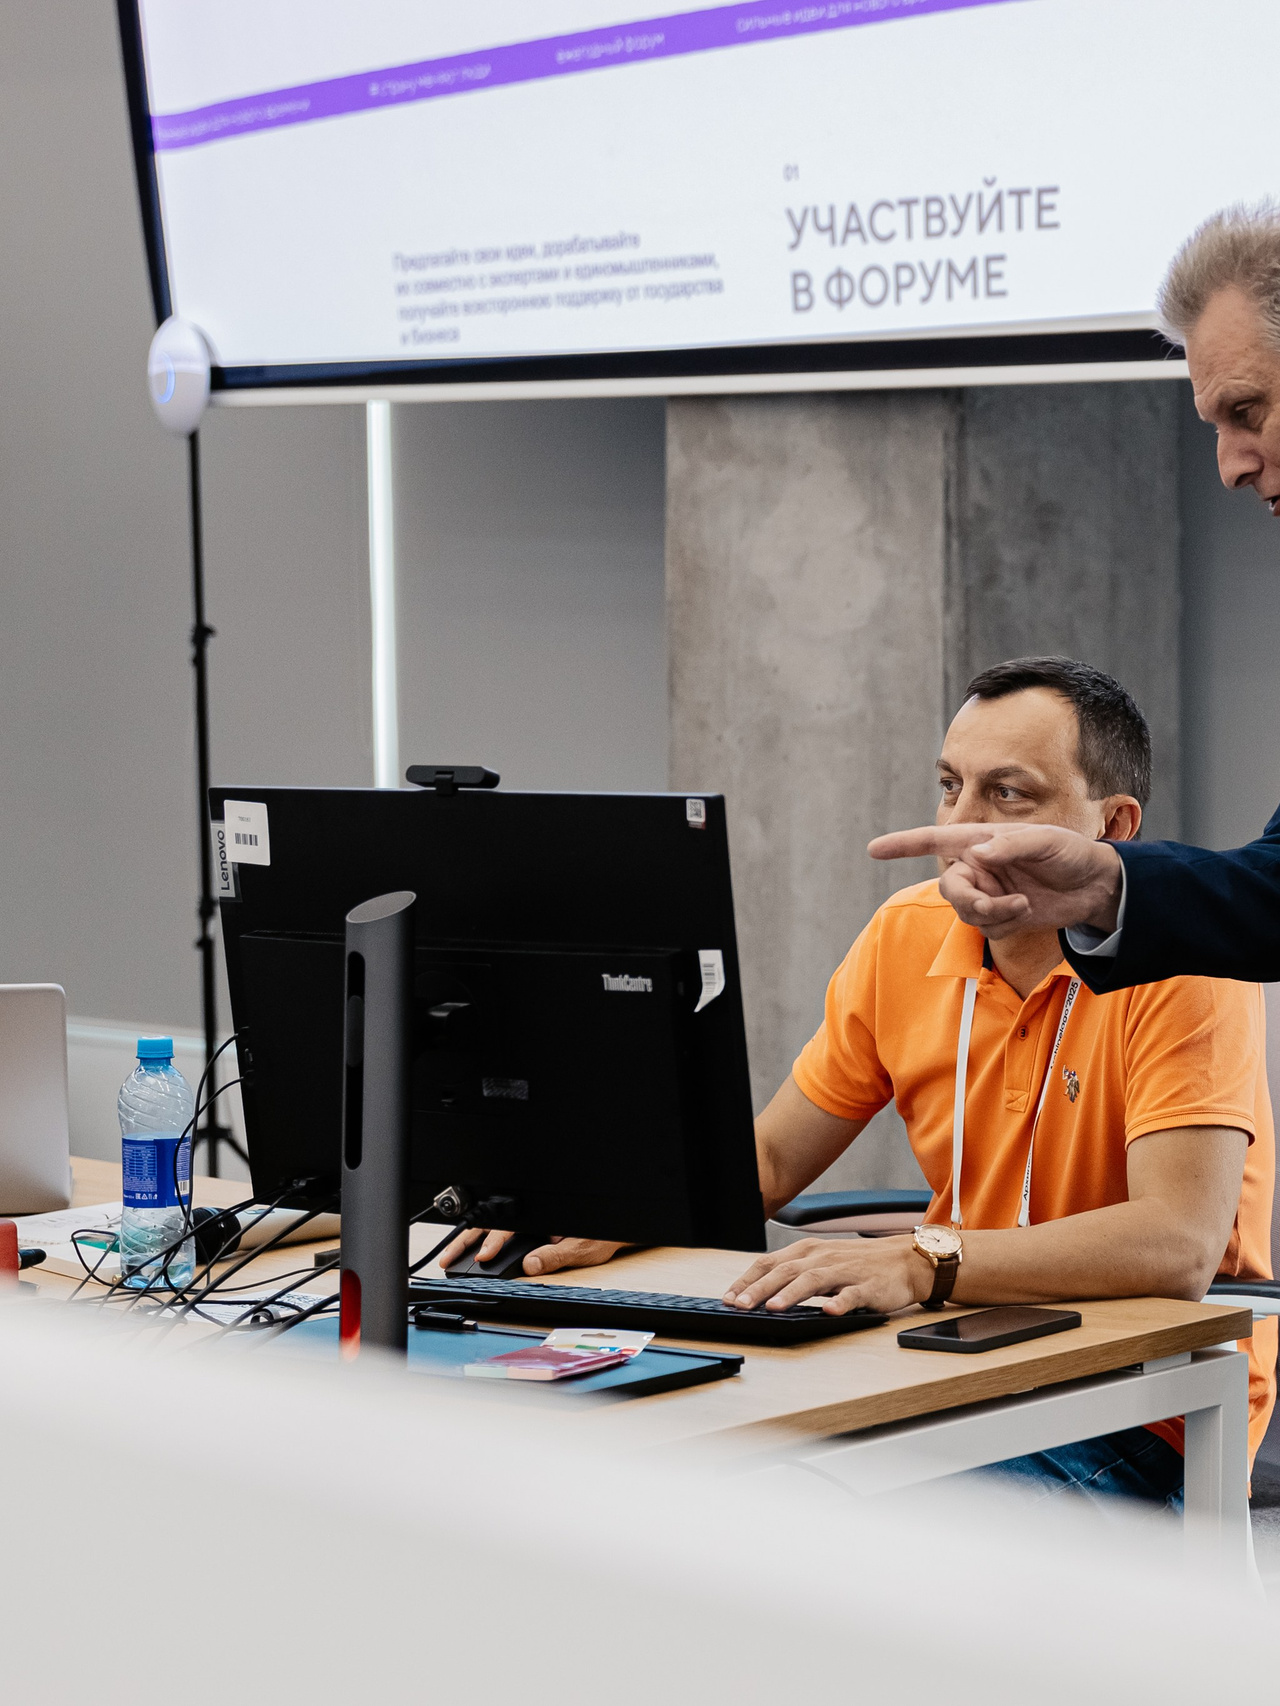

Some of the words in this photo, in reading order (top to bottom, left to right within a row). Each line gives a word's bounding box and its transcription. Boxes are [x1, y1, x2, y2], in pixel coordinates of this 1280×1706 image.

[784, 164, 800, 182] 01
[785, 176, 1061, 251] УЧАСТВУЙТЕ
[791, 270, 814, 313] В
[824, 255, 1008, 312] ФОРУМЕ
[217, 830, 230, 891] Lenovo
